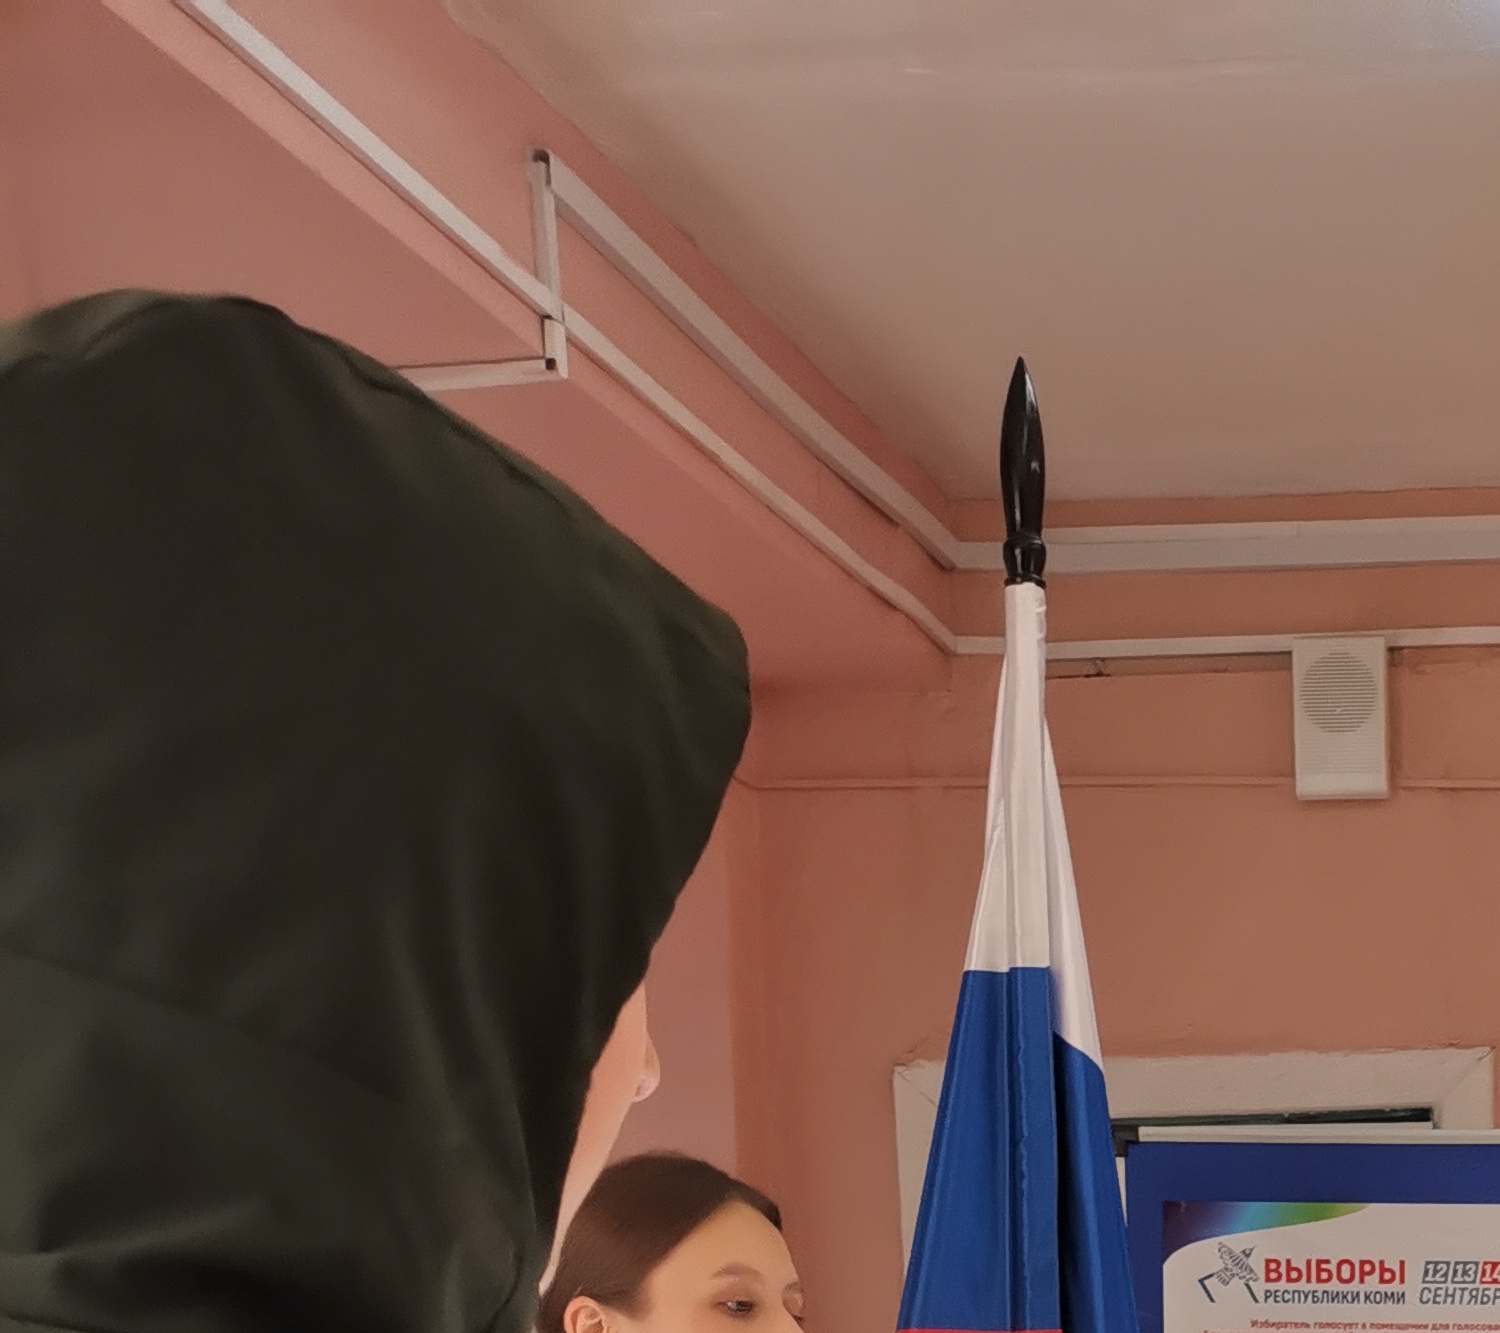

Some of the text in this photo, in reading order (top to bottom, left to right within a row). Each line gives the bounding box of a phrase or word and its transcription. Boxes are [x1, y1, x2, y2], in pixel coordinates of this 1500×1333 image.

[1263, 1257, 1406, 1286] ВЫБОРЫ
[1424, 1263, 1447, 1283] 12
[1453, 1263, 1475, 1283] 13
[1263, 1288, 1360, 1305] РЕСПУБЛИКИ
[1363, 1290, 1406, 1306] КОМИ
